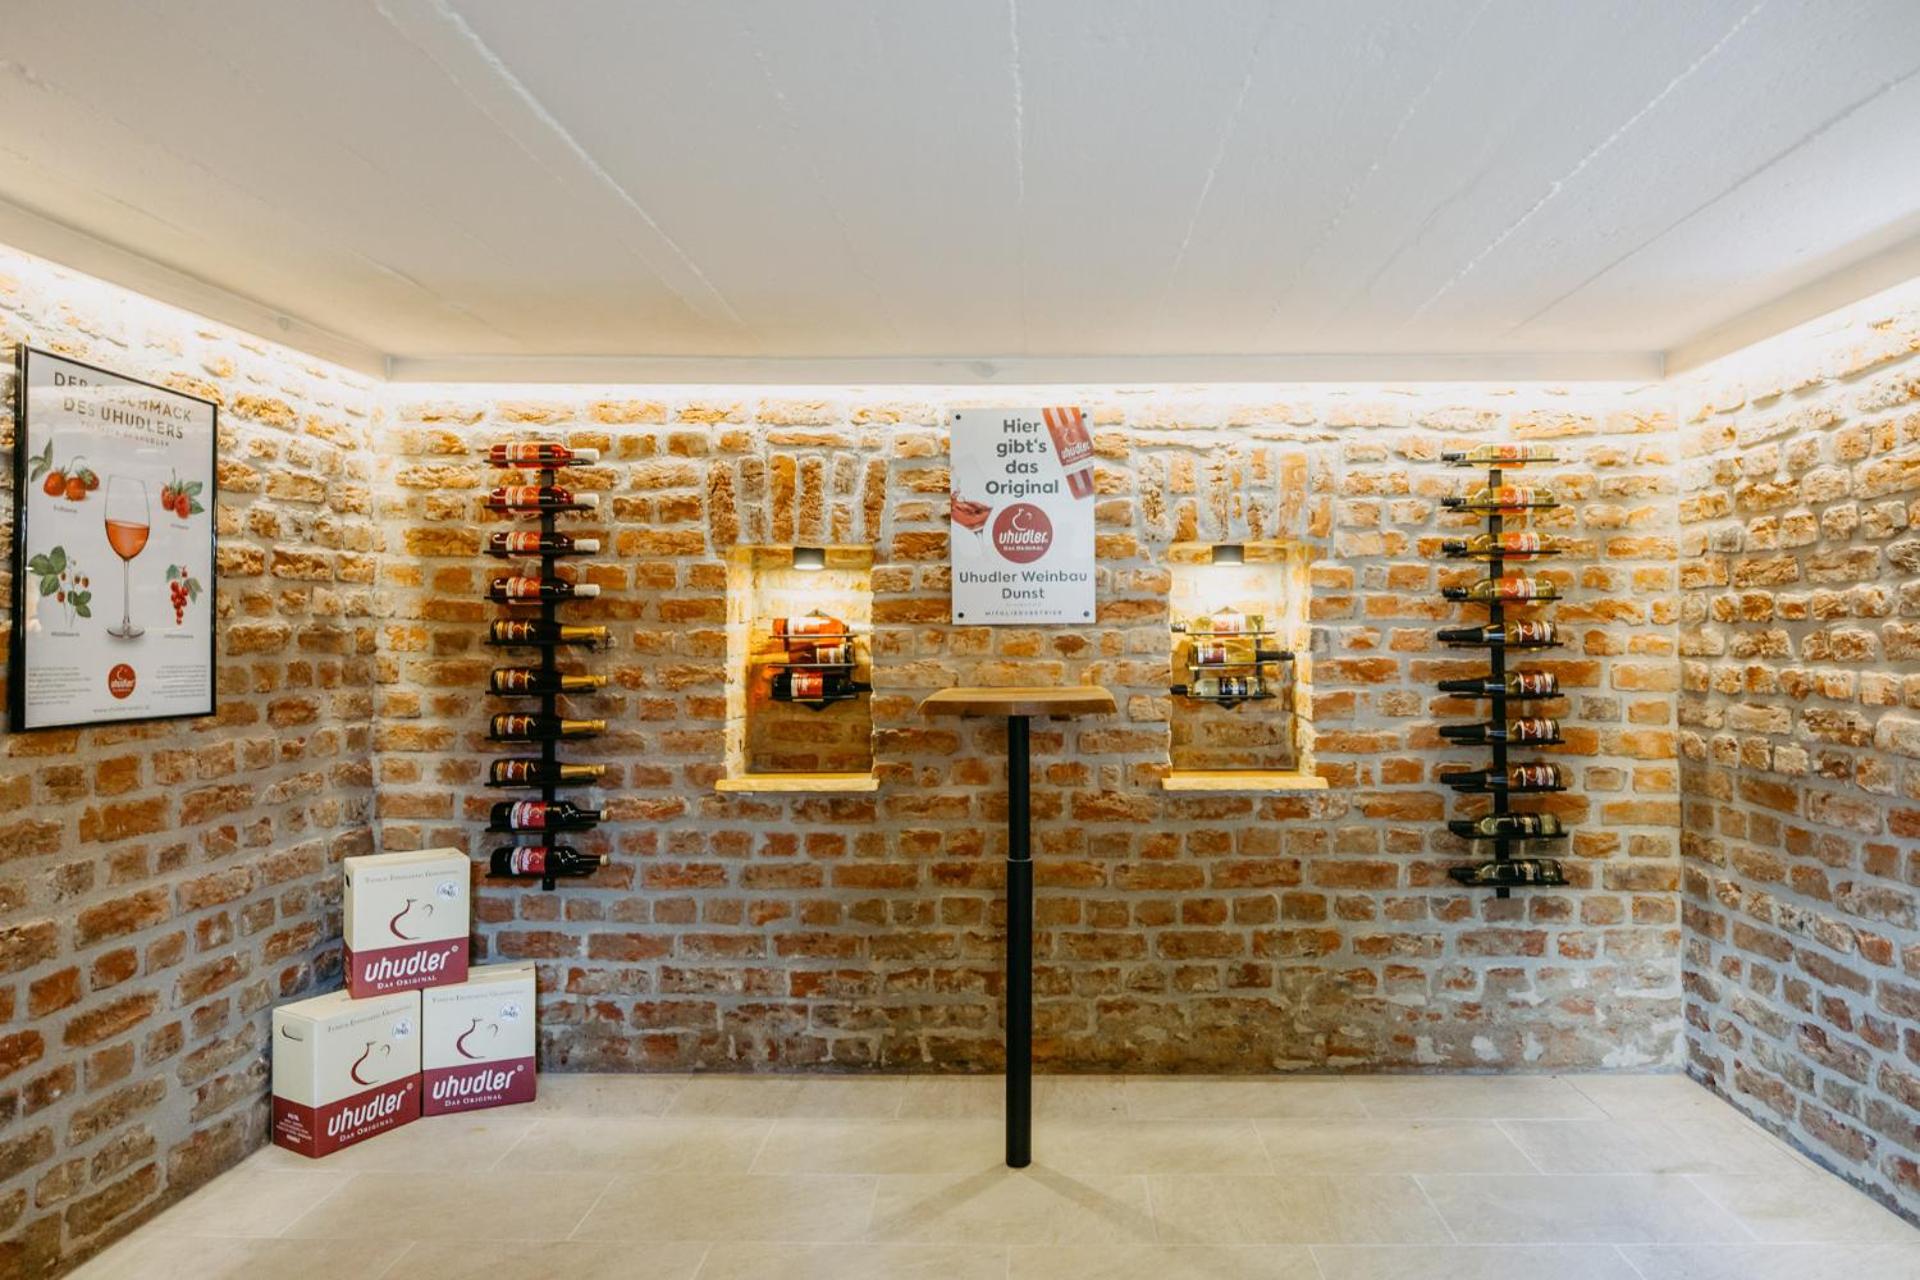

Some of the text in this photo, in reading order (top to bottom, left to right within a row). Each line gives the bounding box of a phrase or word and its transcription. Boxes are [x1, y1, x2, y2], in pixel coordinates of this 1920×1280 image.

[101, 406, 184, 440] UHUDLERS
[1003, 418, 1041, 433] Hier
[1005, 460, 1039, 474] das
[985, 479, 1059, 498] Original
[959, 569, 1088, 583] Uhudler Weinbau
[1001, 587, 1046, 600] Dunst
[364, 950, 451, 983] uhudler
[432, 1069, 516, 1100] uhudler
[327, 1090, 406, 1137] uhudler
